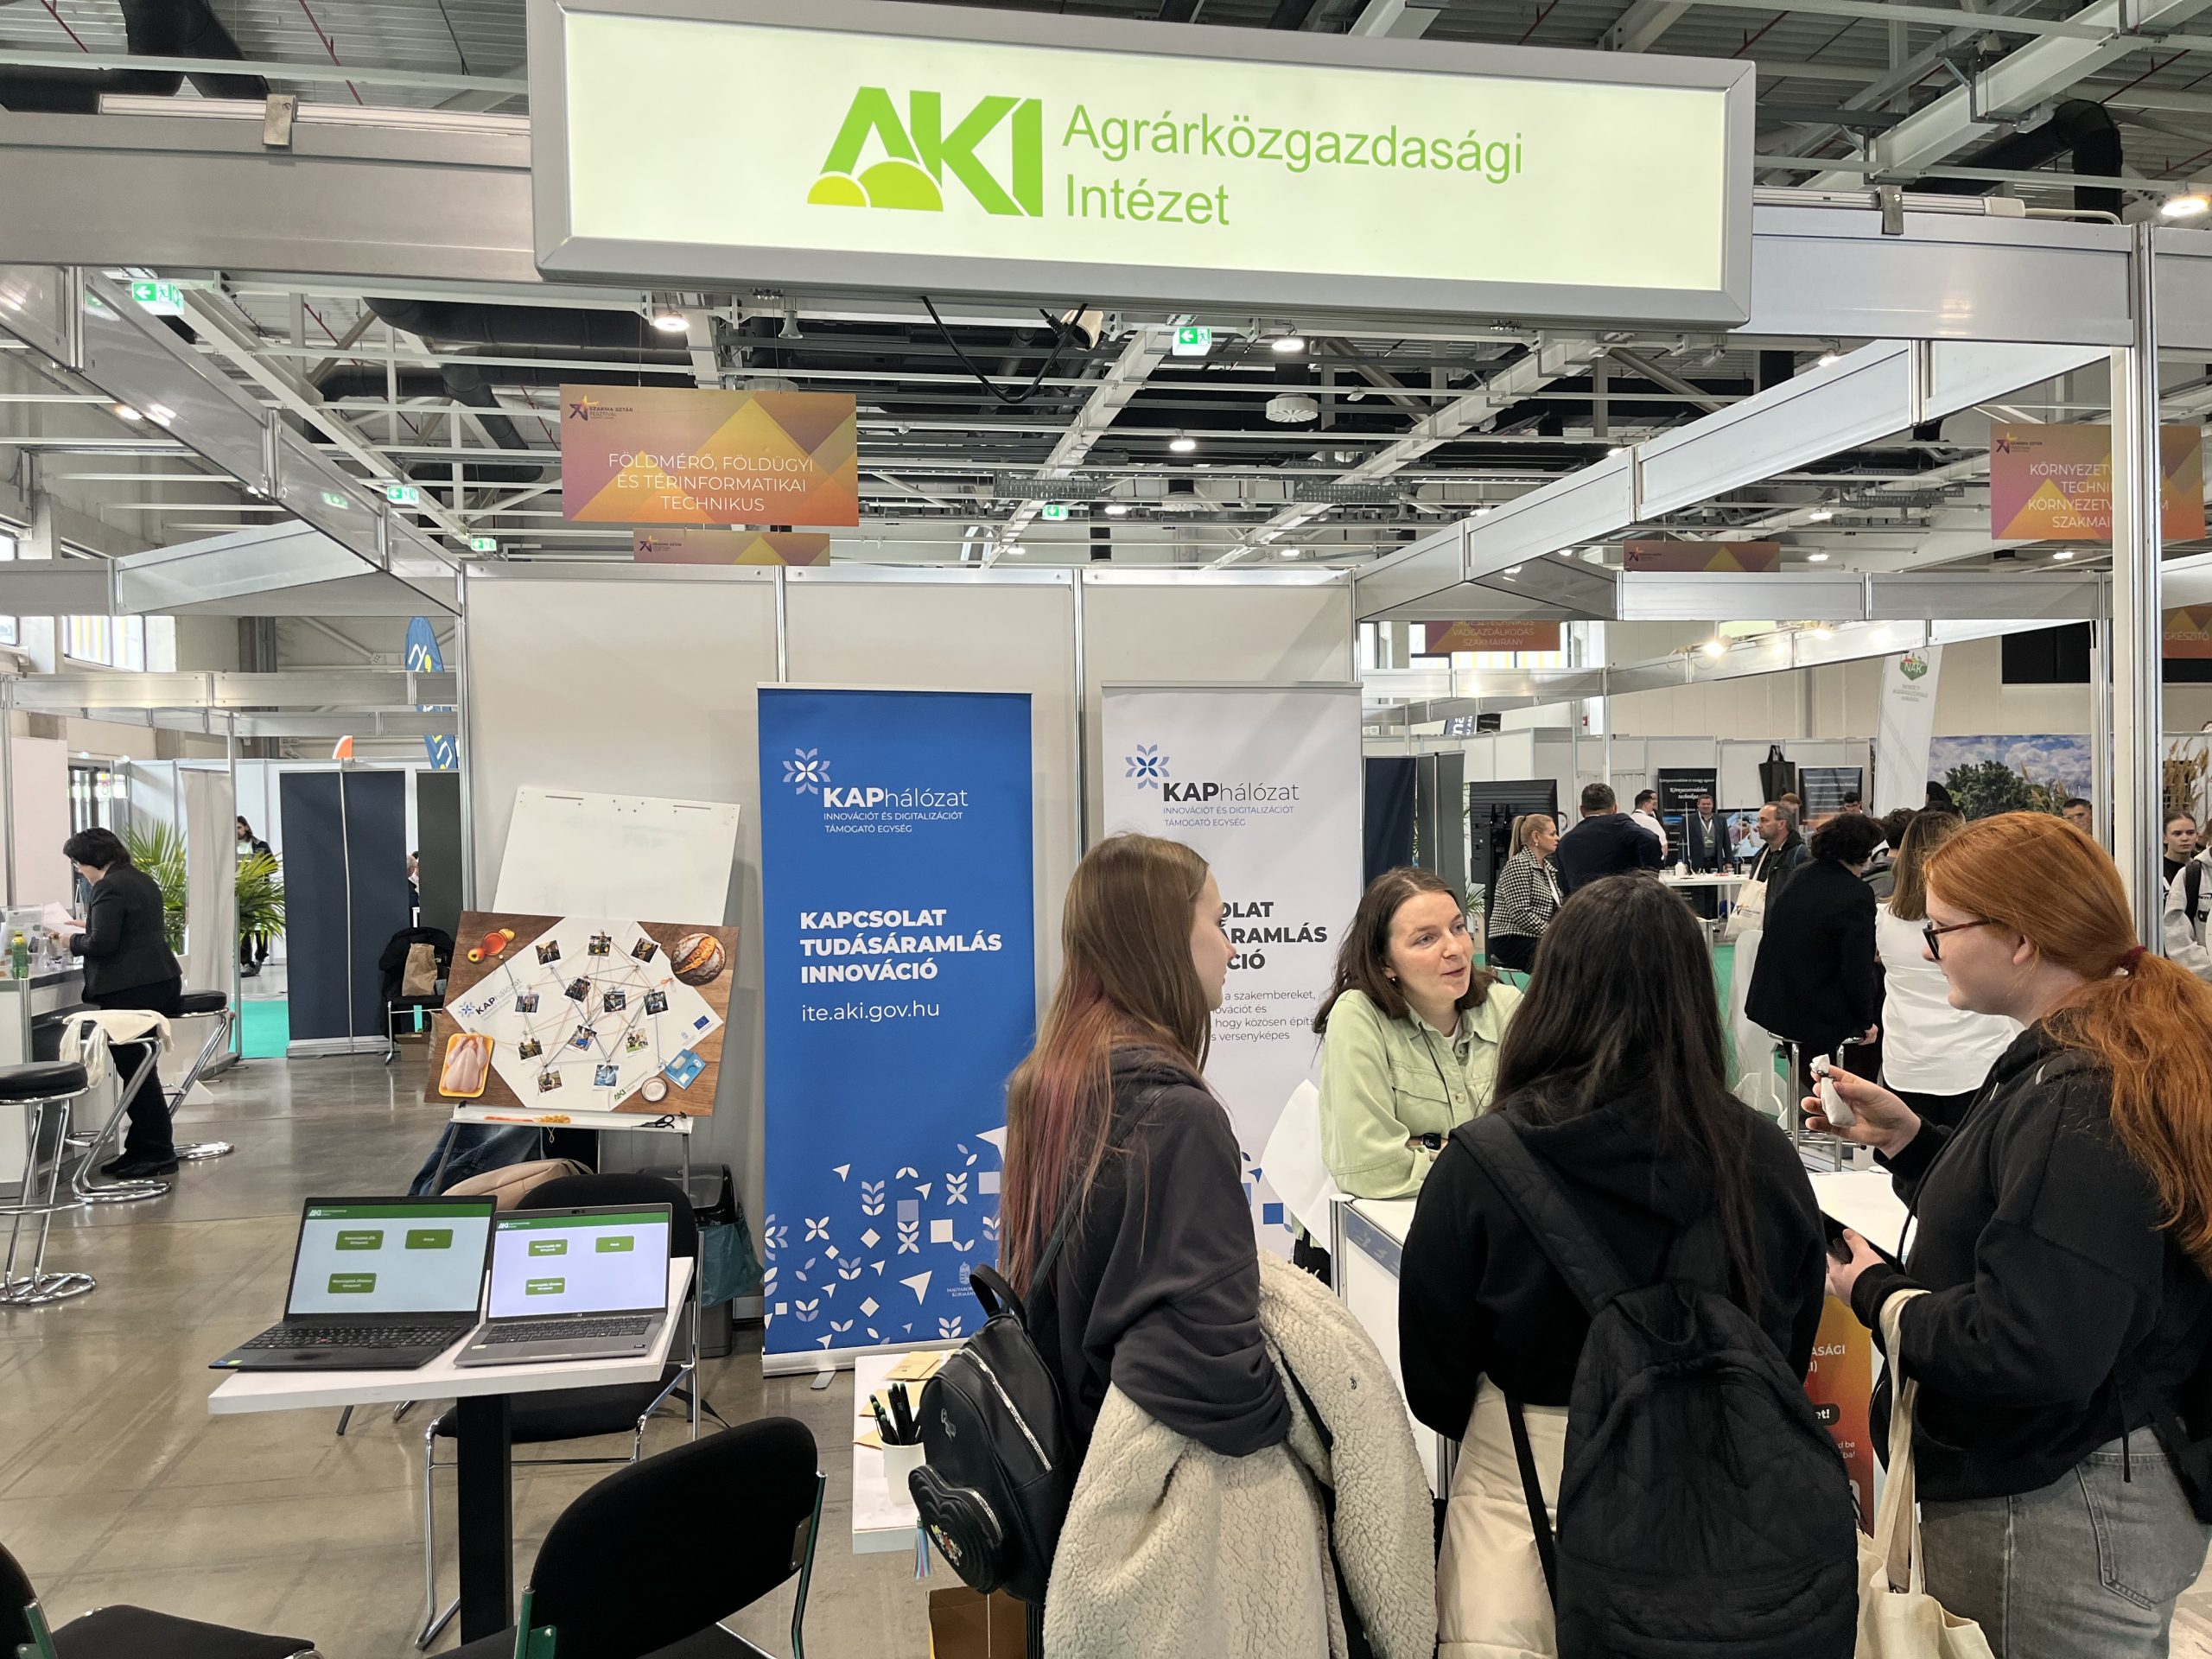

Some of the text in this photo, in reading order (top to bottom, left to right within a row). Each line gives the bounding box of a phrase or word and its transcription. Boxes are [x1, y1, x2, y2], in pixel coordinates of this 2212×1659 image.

[1062, 104, 1524, 185] Agrárközgazdasági
[807, 86, 1043, 218] AKI
[1065, 173, 1230, 228] Intézet
[608, 450, 813, 473] FÖLDMÉRŐ, FÖLDÜGYI
[617, 473, 807, 493] ÉS TÉRINFORMATIKAI
[2061, 481, 2112, 493] TECHNI
[660, 495, 766, 512] TECHNIKUS
[2052, 516, 2111, 529] SZAKMAI
[1452, 626, 1535, 636] VADGAZDÁLKODÁS
[2164, 630, 2209, 641] GKÉSZÍTŐ
[1904, 663, 1923, 674] NAK
[823, 785, 969, 809] KAPhálózat
[1163, 781, 1300, 803] KAPhálózat
[823, 810, 963, 822] INNOVÁCIÓT ÉS DIGITALIZÁCIÓT
[1163, 804, 1294, 815] INNOVÁCIÓT ÉS DIGITALIZÁCIÓT
[825, 823, 912, 833] TÁMOGATÓ EGYSÉG
[1165, 817, 1246, 827] TÁMOGATÓ EGYSÉG
[1221, 901, 1274, 918] OLAT
[800, 908, 946, 930] KAPCSOLAT
[799, 930, 1002, 957] TUDÁSÁRAMLÁS
[1226, 948, 1266, 969] CIÓ
[800, 958, 938, 984] INNOVÁCIÓ
[474, 978, 522, 1015] KAPhálóat
[1234, 990, 1316, 1001] szakembereket,
[801, 1000, 940, 1023] ite.aki.gov.hu
[1212, 1004, 1267, 1014] ovációt és
[1215, 1017, 1315, 1029] hogy közösen építs
[1219, 1031, 1290, 1042] versenyképes
[613, 1089, 626, 1102] AKI
[1812, 1343, 1846, 1357] ASÁGI
[1809, 1361, 1818, 1373] I)
[1841, 1451, 1855, 1459] ba!
